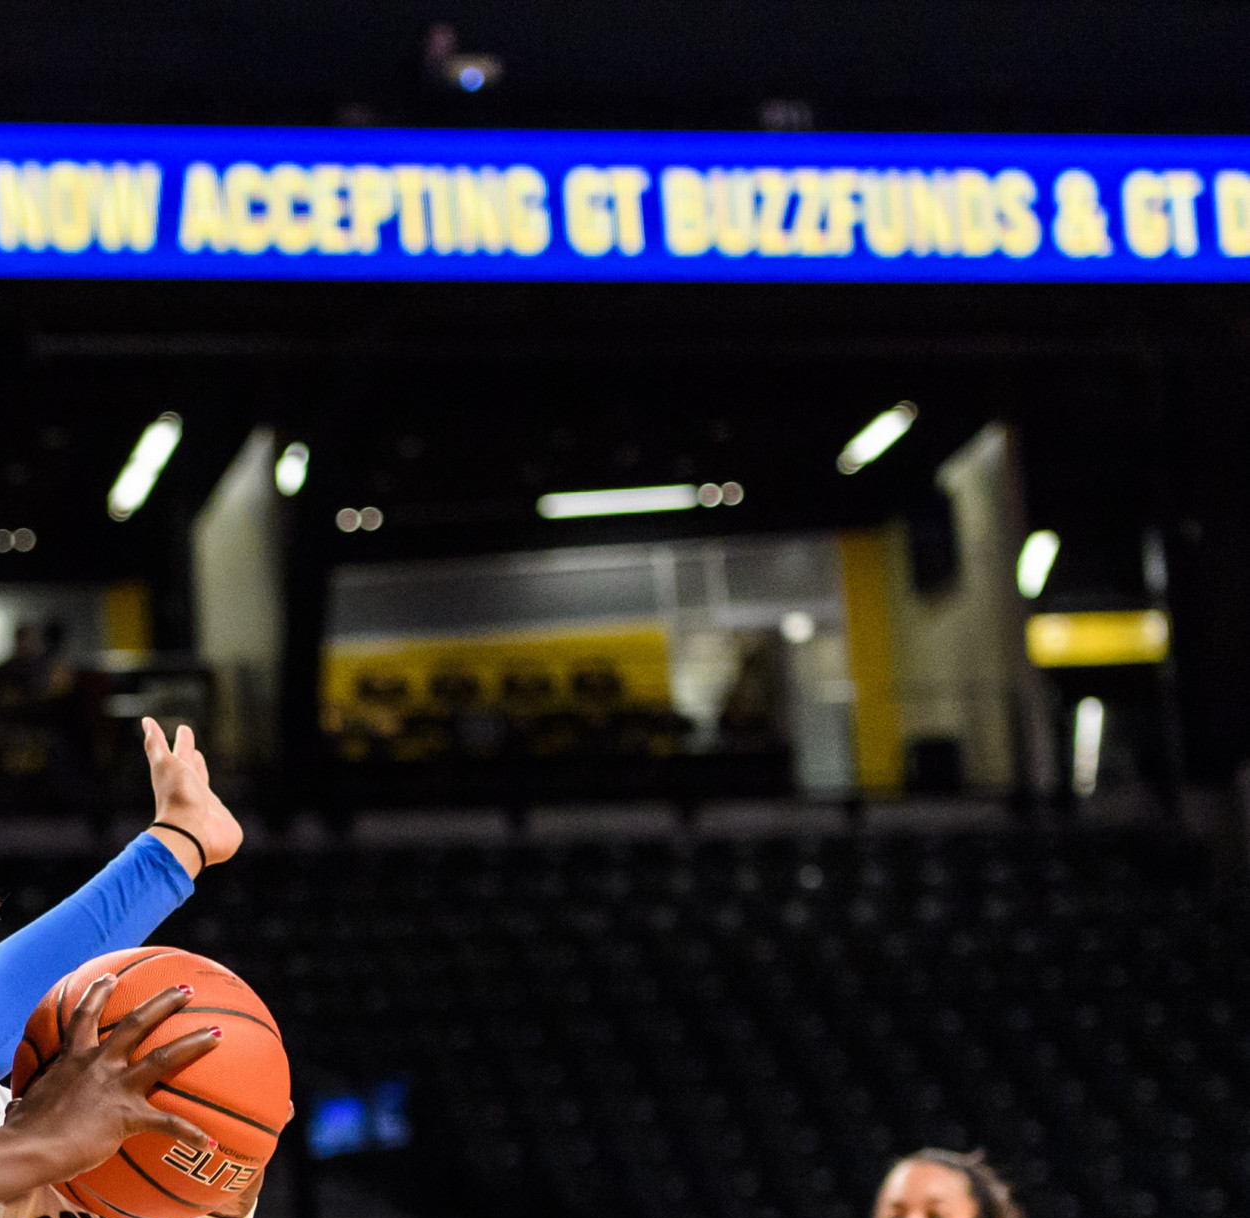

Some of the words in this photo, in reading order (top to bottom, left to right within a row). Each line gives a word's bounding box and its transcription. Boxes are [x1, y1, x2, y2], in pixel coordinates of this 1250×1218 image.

[178, 161, 550, 257] ACCEPTING
[563, 164, 648, 257] GT
[661, 166, 1041, 258] BUZZFUNDS
[1052, 168, 1114, 259] &
[1121, 167, 1205, 260] GT
